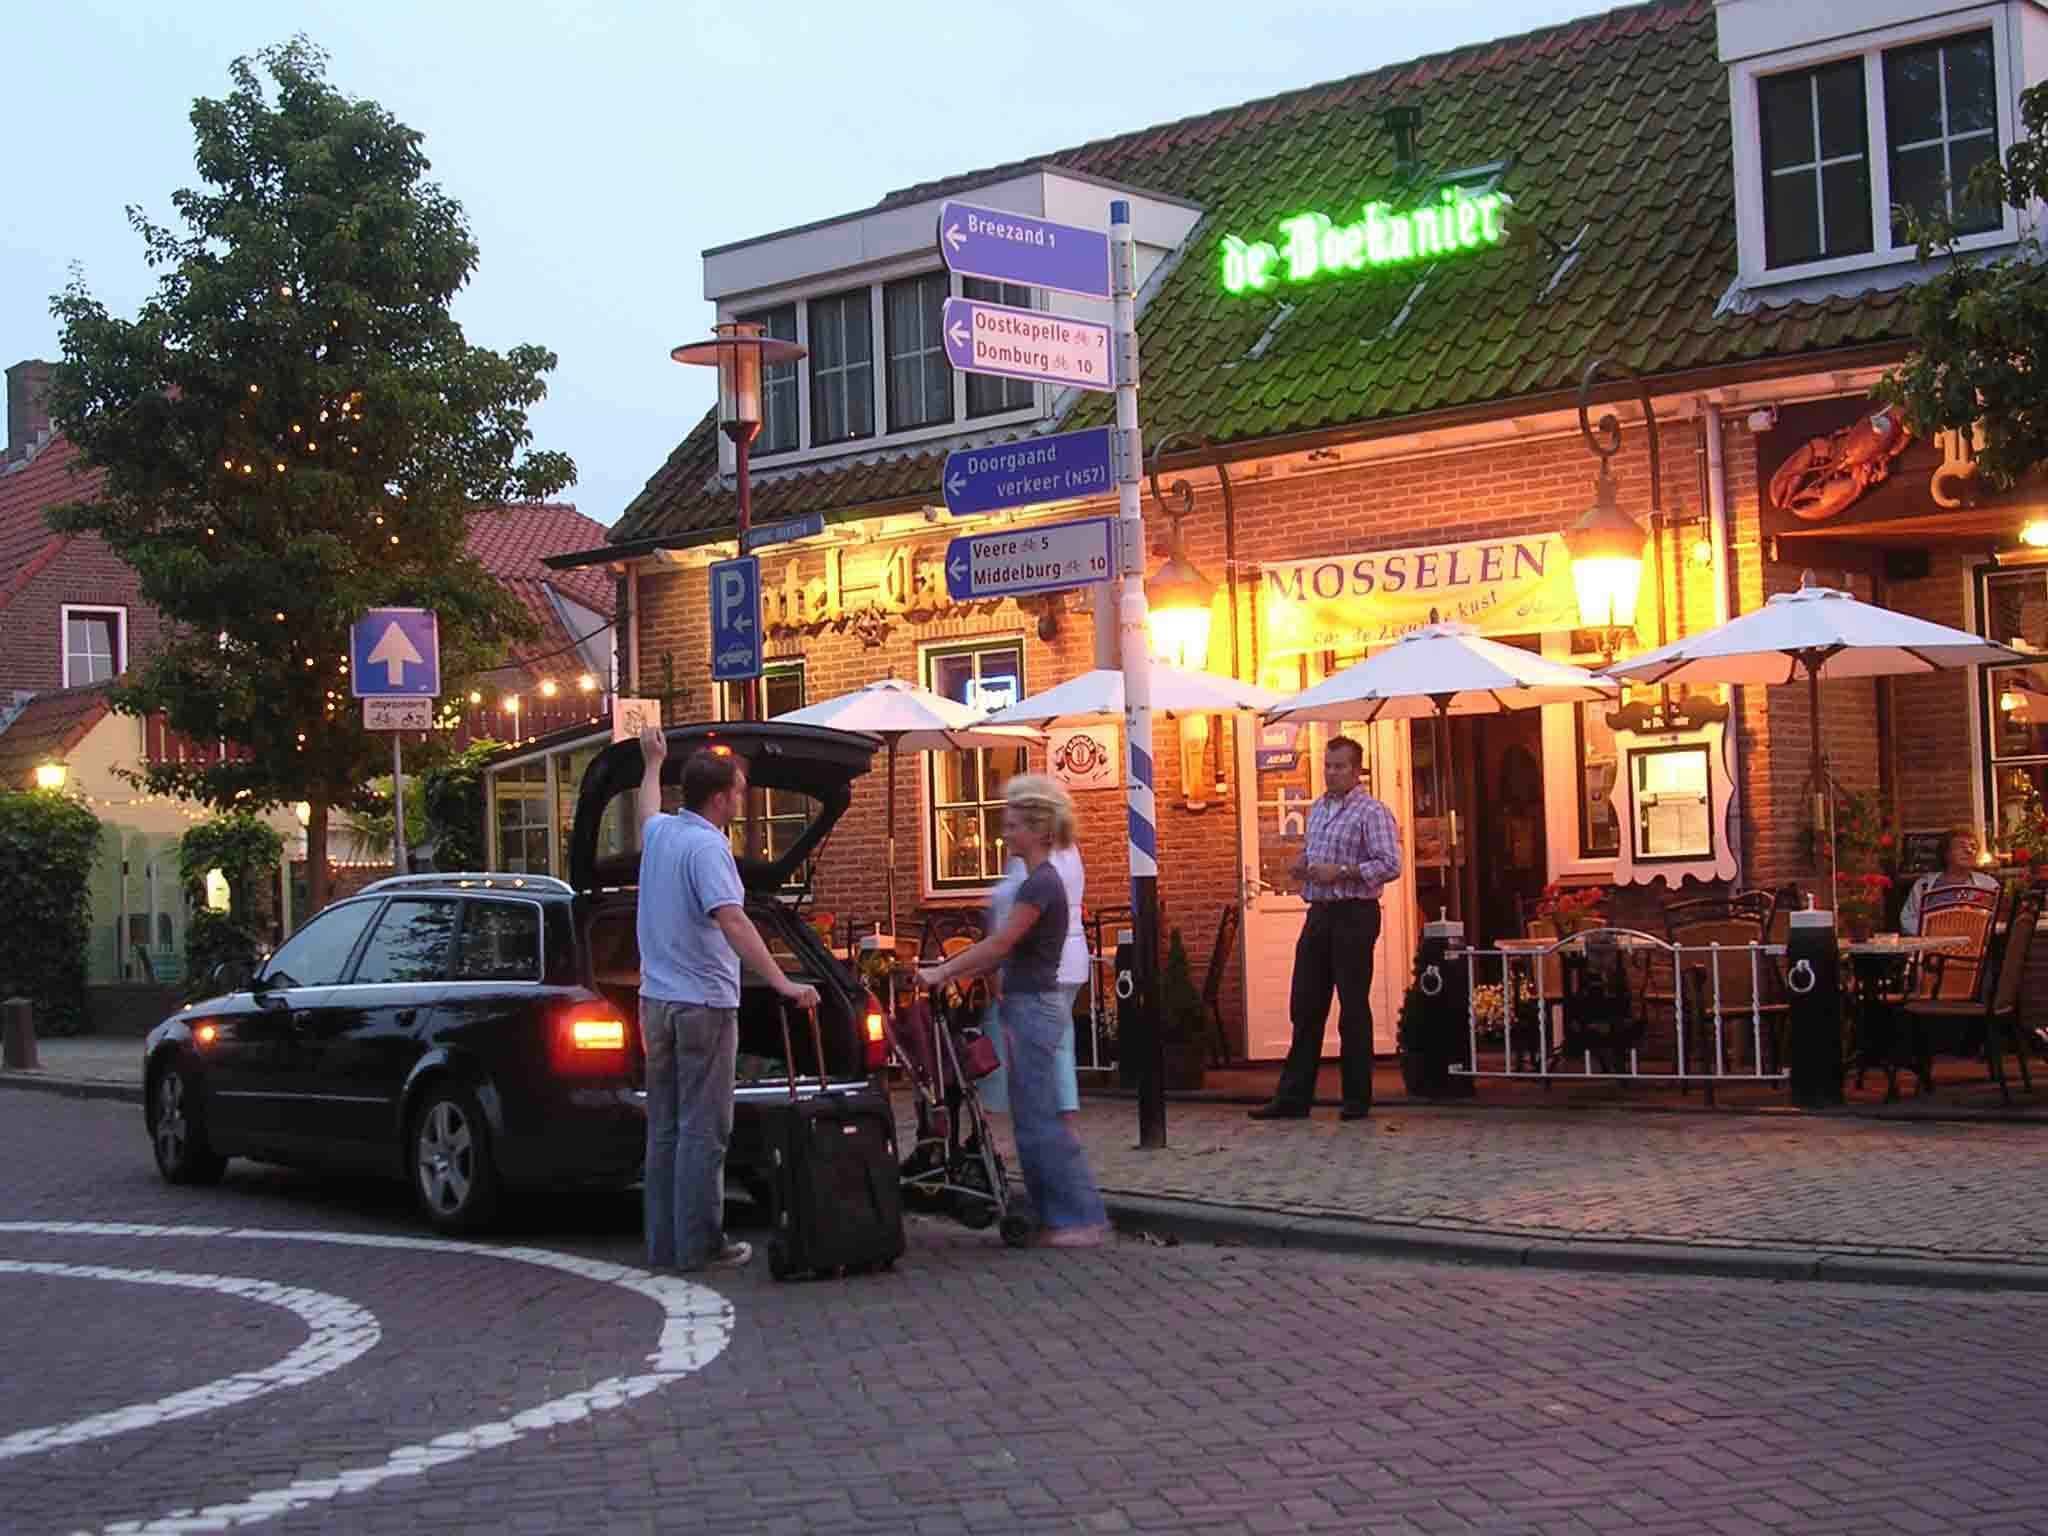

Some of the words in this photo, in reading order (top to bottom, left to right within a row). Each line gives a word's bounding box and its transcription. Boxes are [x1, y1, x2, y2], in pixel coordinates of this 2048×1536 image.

[967, 213, 1044, 247] Breezand
[1049, 233, 1056, 249] 1
[1279, 185, 1504, 281] Boekanier
[975, 311, 1070, 343] Oostkapelle
[1096, 335, 1104, 348] 7
[976, 340, 1049, 371] Domburg
[1077, 359, 1093, 374] 10
[967, 443, 1057, 475] Doorgaand
[997, 475, 1064, 497] verkeer
[1065, 466, 1106, 489] (N57)
[973, 540, 1018, 559] Veere
[1041, 537, 1049, 550] 5
[973, 560, 1062, 586] Middelburg
[1090, 557, 1106, 571] 10
[1266, 539, 1549, 602] MOSSELEN
[720, 571, 745, 631] P
